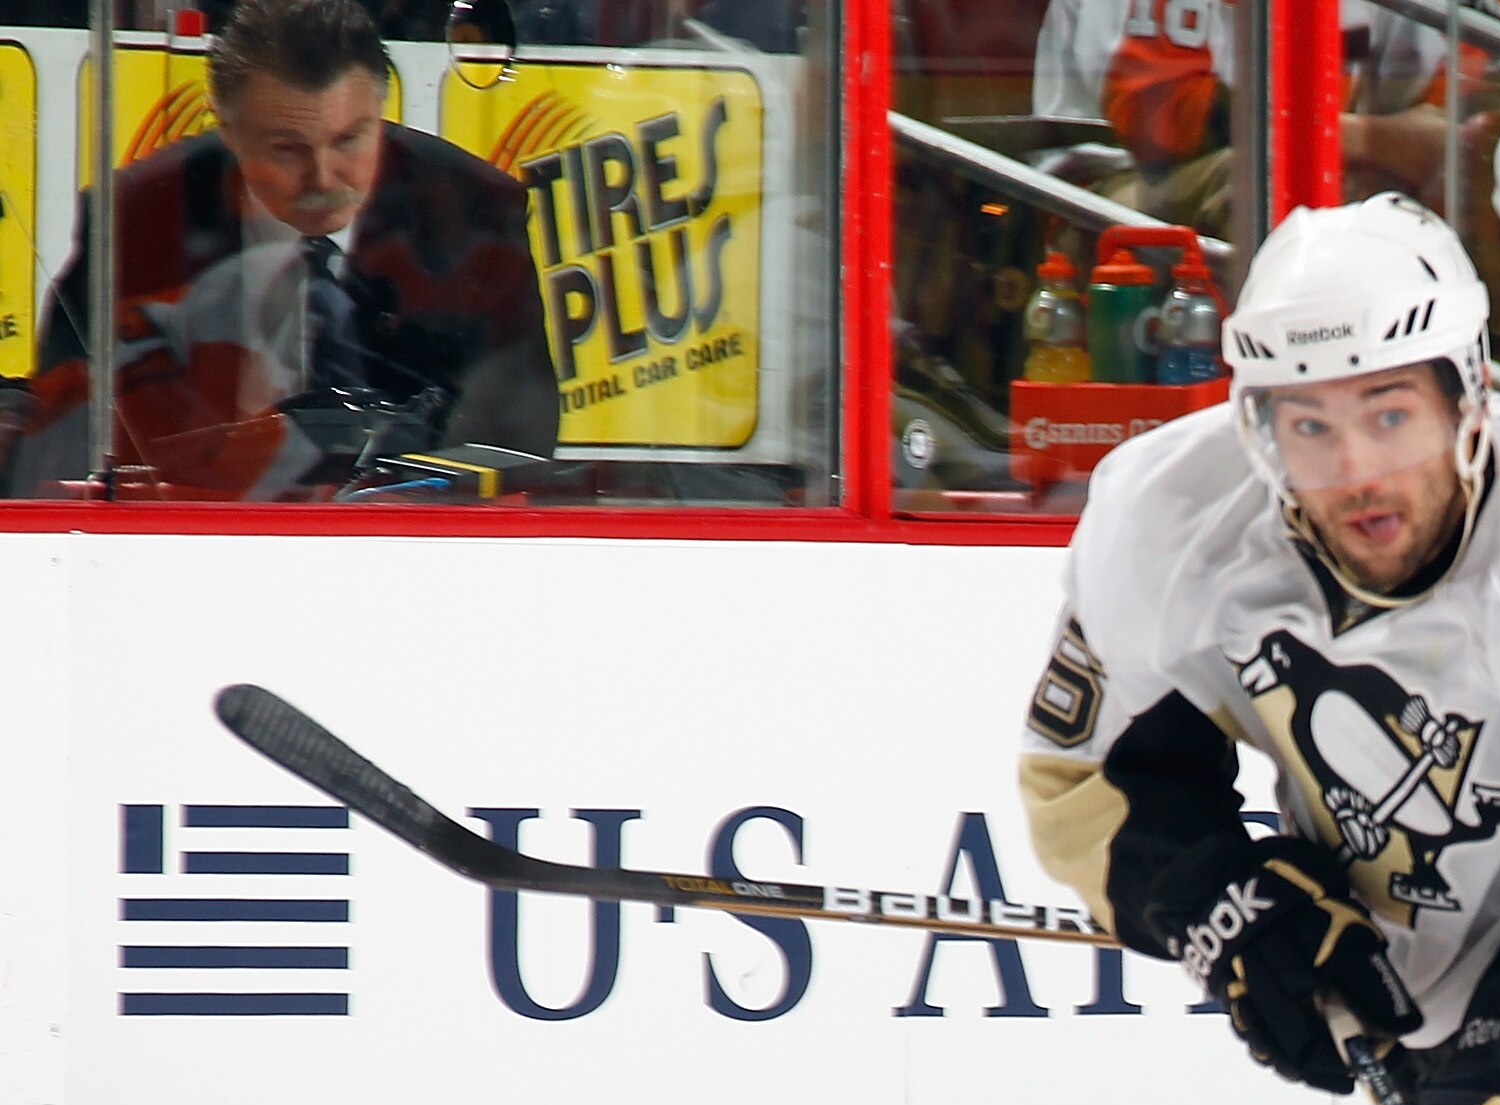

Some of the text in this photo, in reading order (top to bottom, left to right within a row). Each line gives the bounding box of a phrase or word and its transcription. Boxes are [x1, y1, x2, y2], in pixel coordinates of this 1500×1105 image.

[519, 93, 728, 270] TIRES
[545, 211, 733, 383] PLUS
[1284, 323, 1355, 347] Reebok
[558, 333, 744, 414] TOTAL CAR CARE
